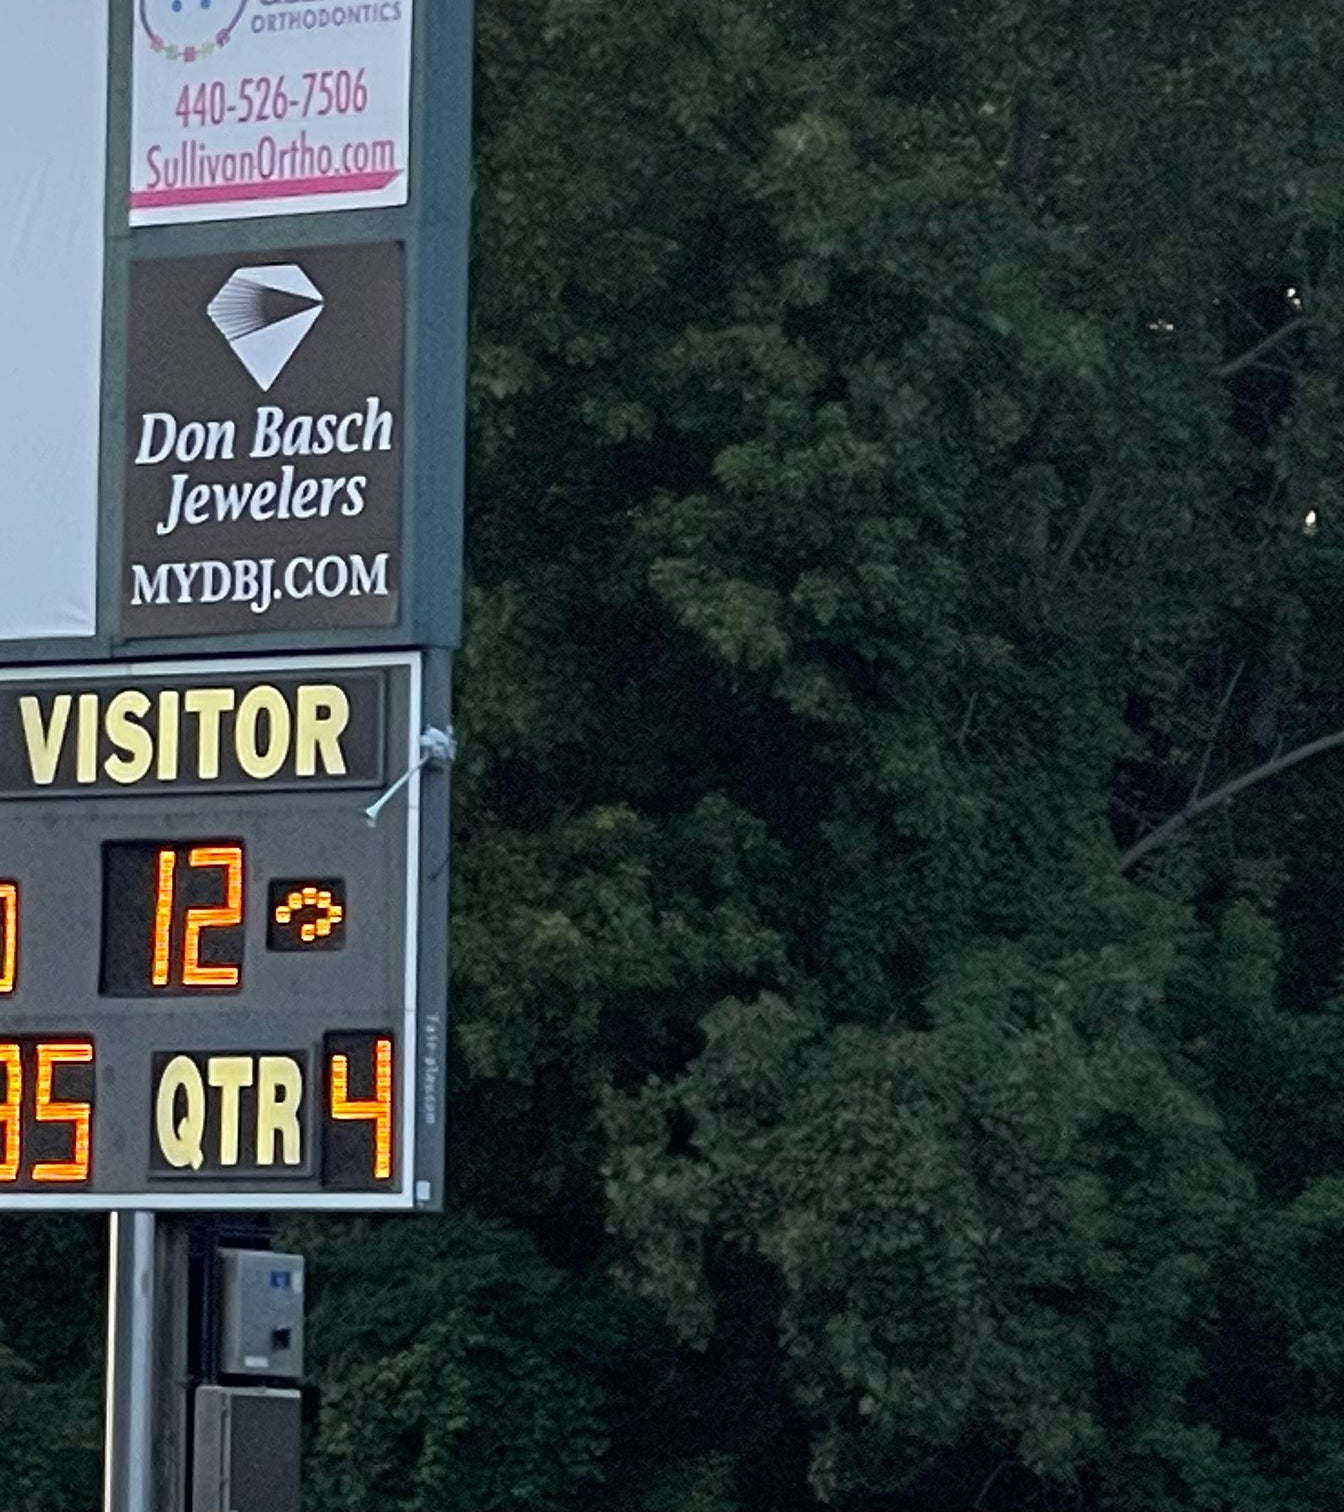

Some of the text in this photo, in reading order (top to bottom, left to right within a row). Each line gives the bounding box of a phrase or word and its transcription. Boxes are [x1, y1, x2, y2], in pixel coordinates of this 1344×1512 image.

[251, 1, 402, 34] ORTHODONTICS
[175, 68, 368, 127] 440-526-7506
[146, 130, 395, 189] SullivanOrtho.com
[135, 396, 394, 465] Don Basch
[156, 465, 367, 536] Jewelers
[131, 553, 391, 614] MYDBJ.COM
[19, 684, 351, 785] VISITOR
[151, 847, 243, 986] 12
[156, 1054, 303, 1171] QTR
[328, 1039, 392, 1179] 4
